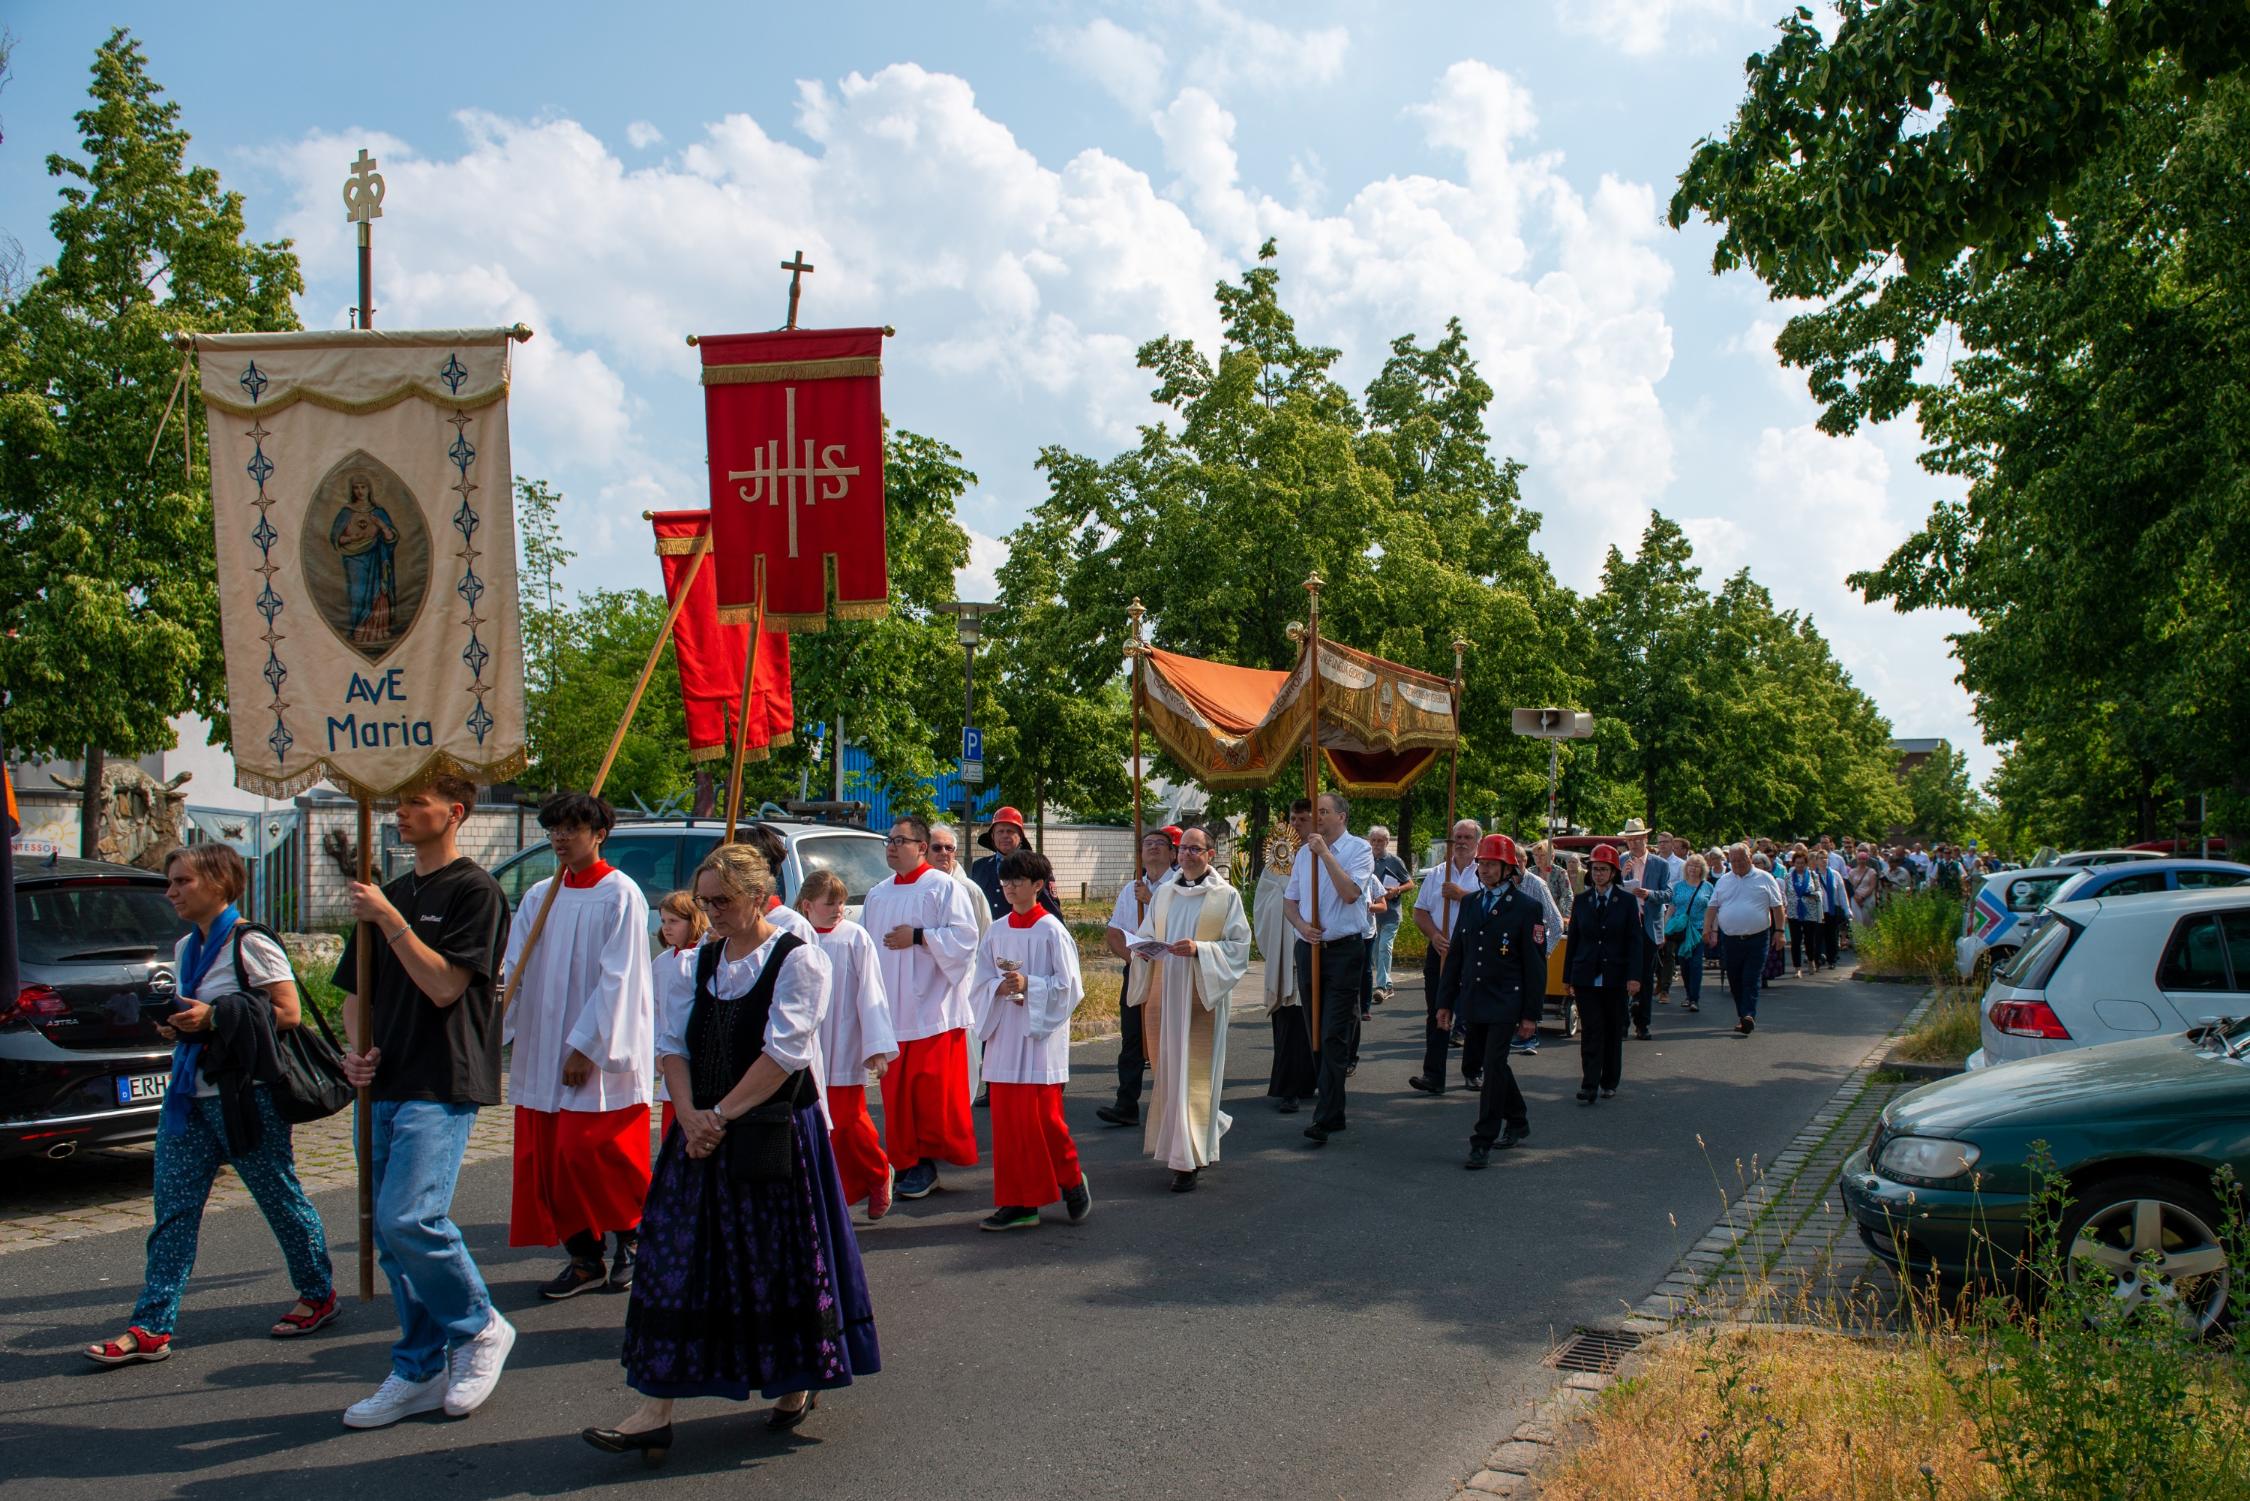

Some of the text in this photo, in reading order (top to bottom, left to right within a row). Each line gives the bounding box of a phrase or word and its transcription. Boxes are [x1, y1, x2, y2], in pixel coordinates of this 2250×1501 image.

[345, 669, 407, 705] AVE
[327, 714, 433, 752] Maria
[967, 732, 978, 757] P
[130, 1075, 167, 1098] ERH
